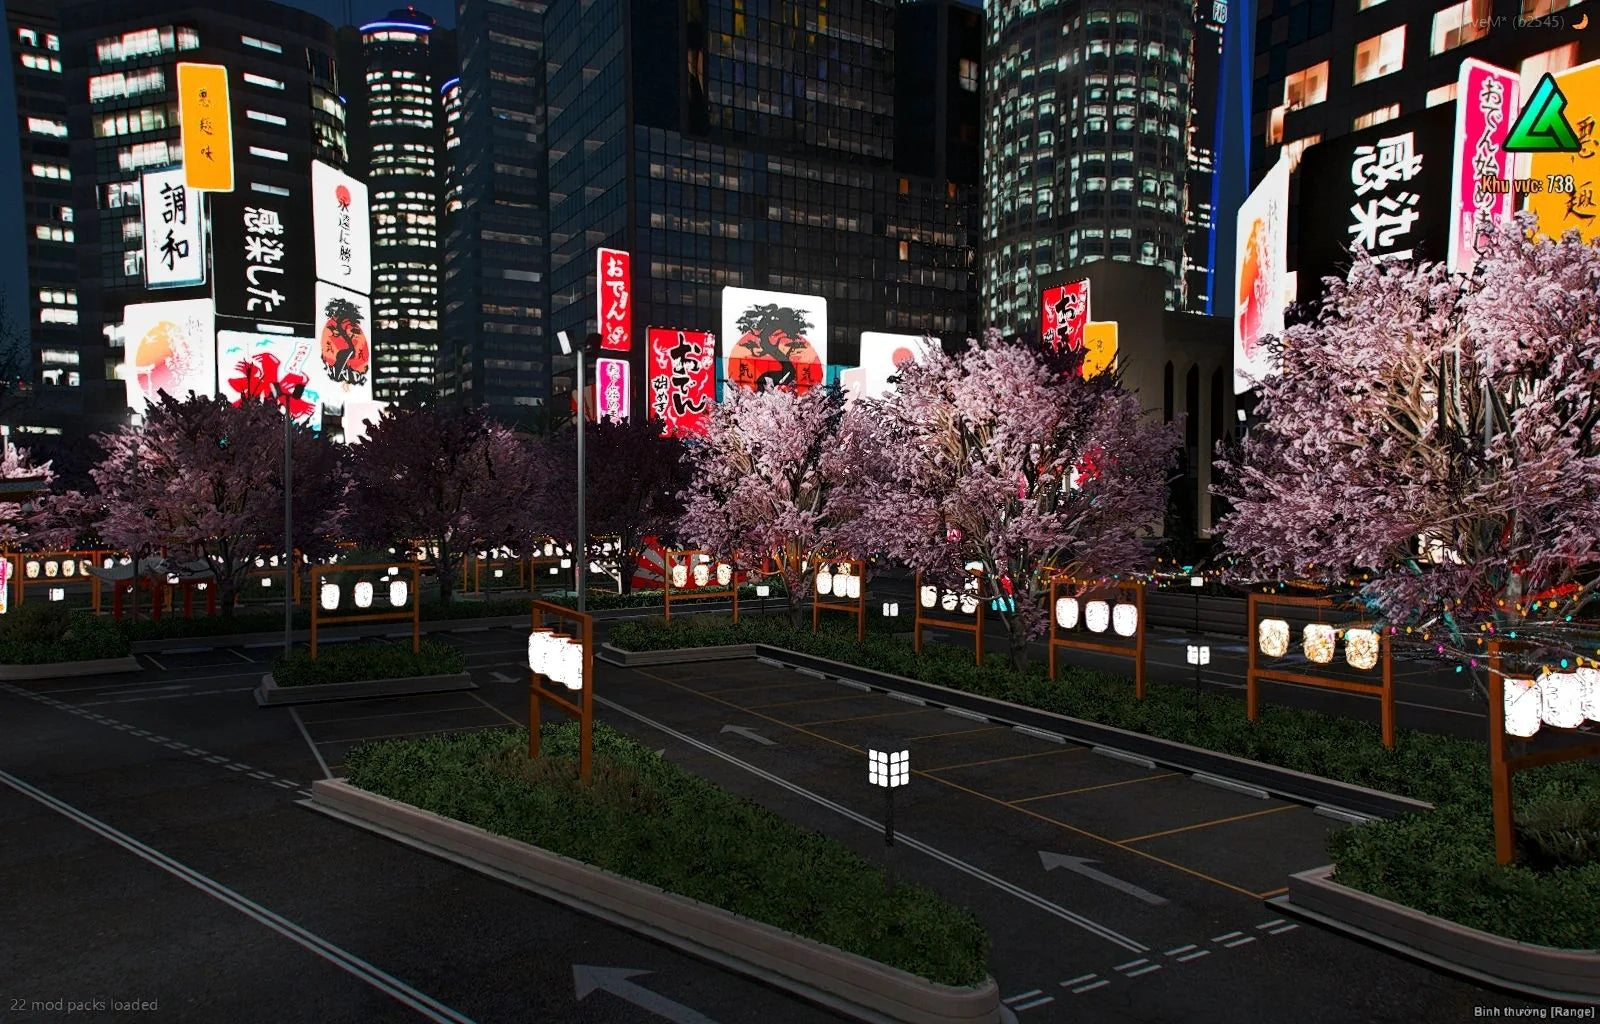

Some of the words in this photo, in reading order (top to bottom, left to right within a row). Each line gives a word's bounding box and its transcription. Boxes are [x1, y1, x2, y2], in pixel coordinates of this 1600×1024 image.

[159, 182, 190, 272] 調和
[243, 206, 286, 312] 感染した
[605, 256, 627, 321] おでん
[670, 332, 707, 416] おでん
[740, 363, 753, 379] 気
